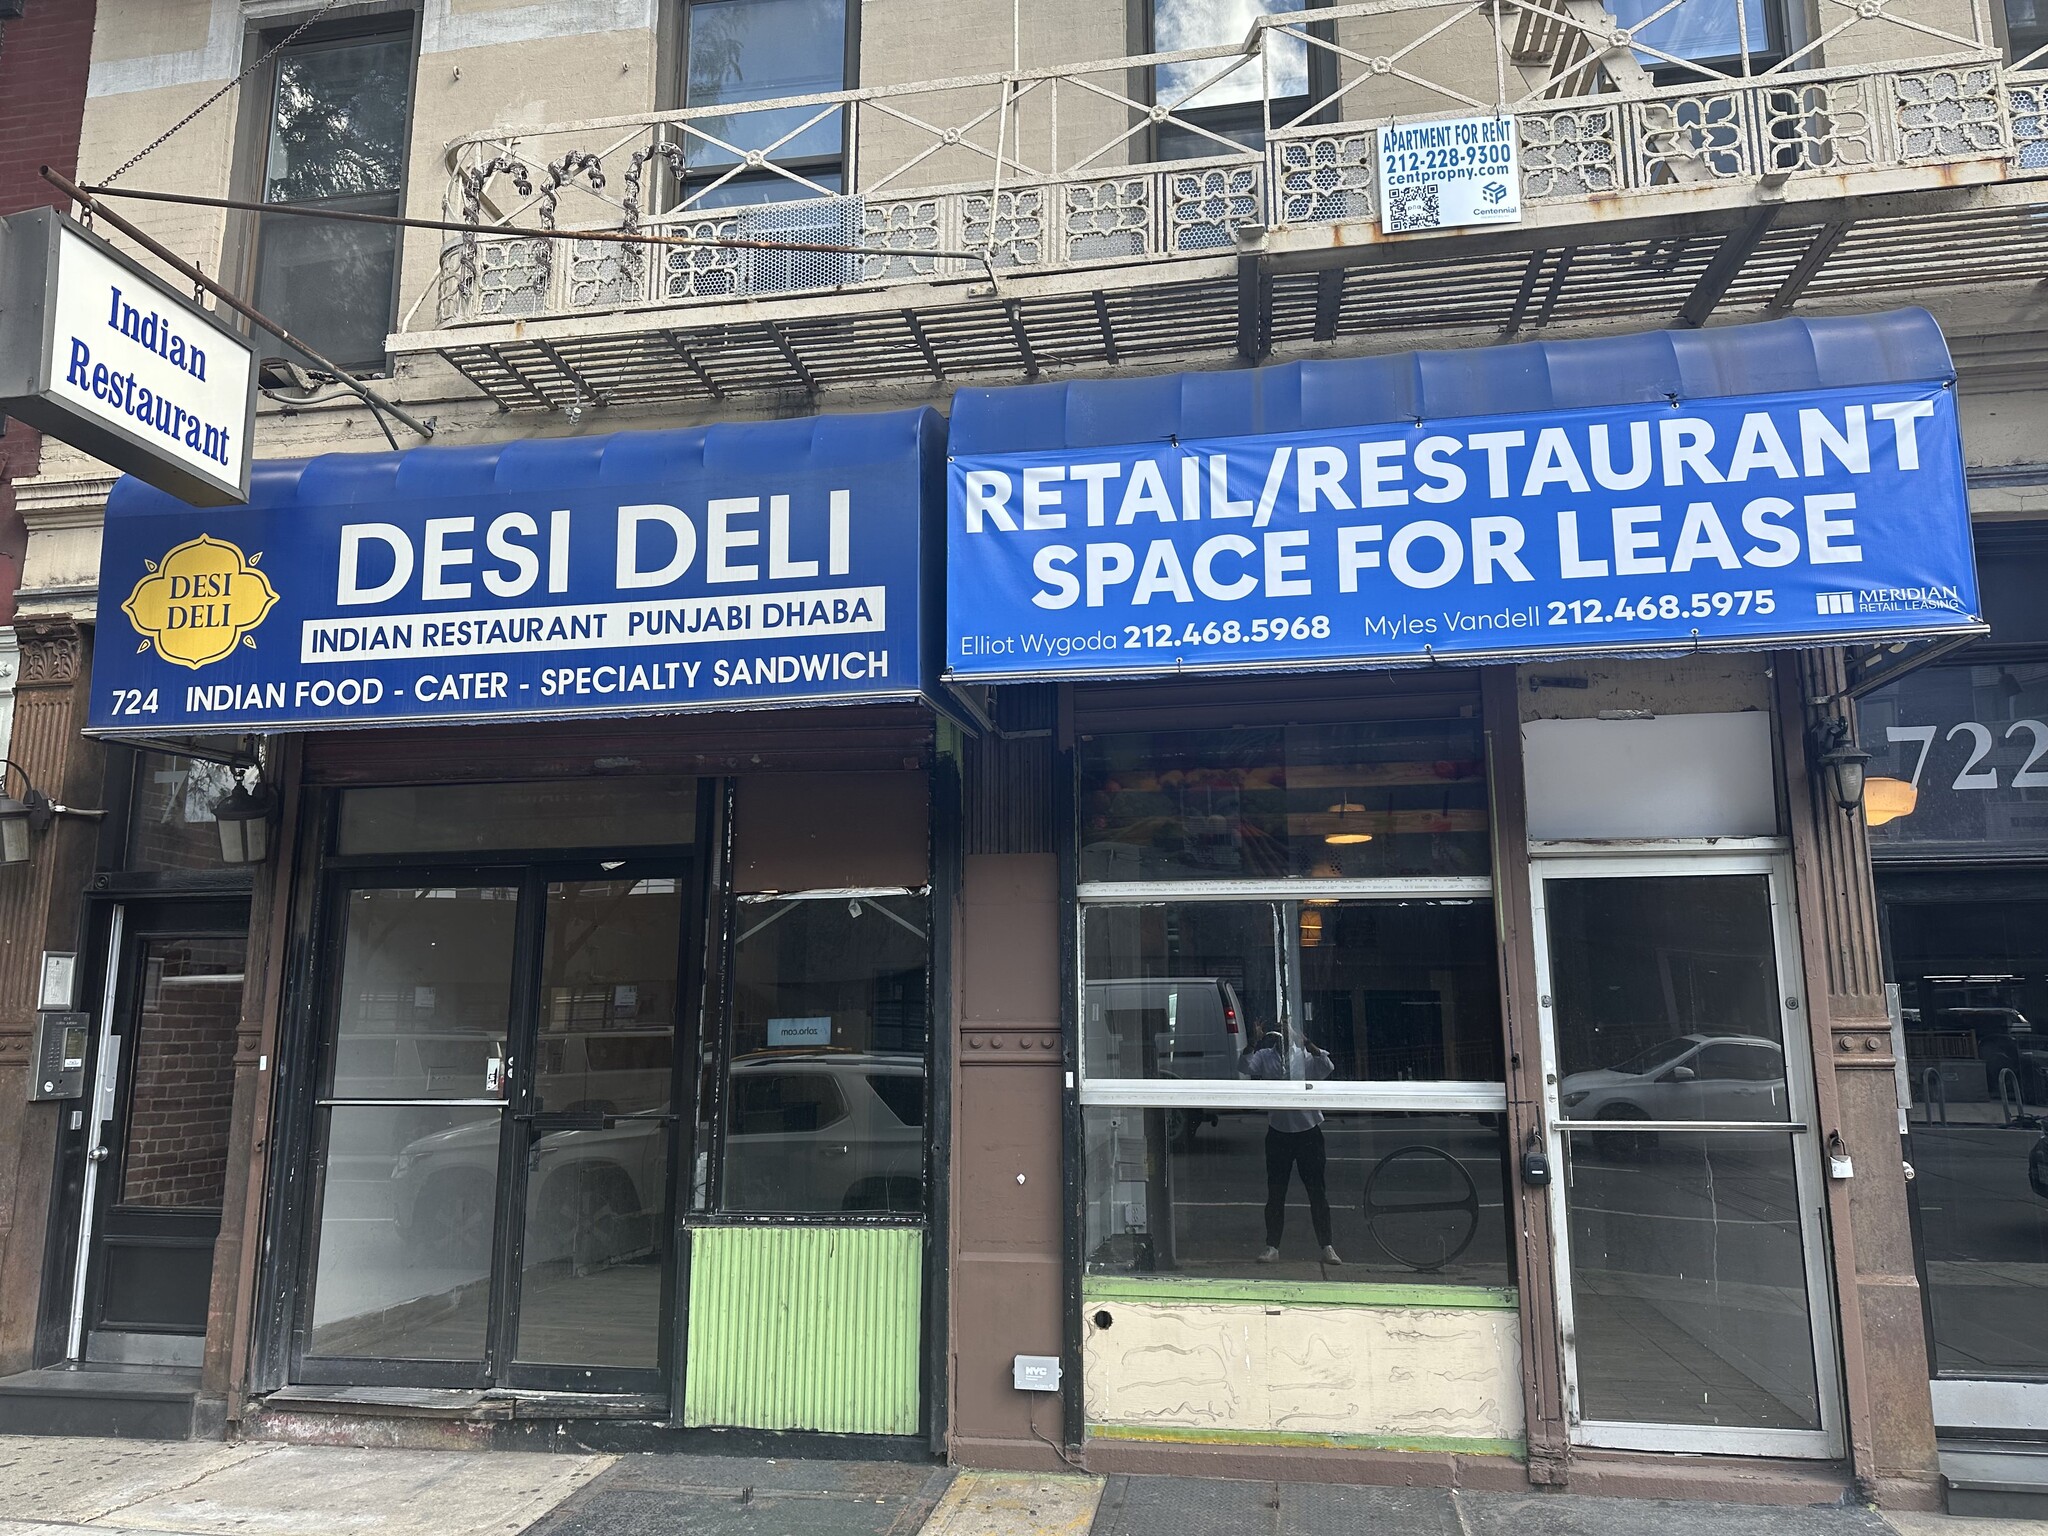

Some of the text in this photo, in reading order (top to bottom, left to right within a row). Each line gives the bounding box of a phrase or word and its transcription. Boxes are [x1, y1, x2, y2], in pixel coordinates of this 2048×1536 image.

[1383, 121, 1510, 153] APARTMENT FOR RENT
[1386, 144, 1510, 174] 212-228-9300
[1388, 164, 1508, 186] centpropny.com
[1473, 207, 1516, 215] Centennial
[108, 285, 206, 382] Indian
[66, 336, 230, 466] Restaurant
[966, 400, 1934, 533] RETAIL/RESTAURANT
[337, 490, 850, 606] DESI DELI
[1031, 492, 1863, 610] SPACE FOR LEASE
[169, 573, 231, 599] DESI
[1859, 586, 1957, 603] MERIDIAN
[167, 603, 230, 630] DELI
[1364, 590, 1775, 640] Myles Vandell 212.468.5975
[1860, 599, 1959, 612] RETAIL LEASING
[312, 598, 872, 653] INDIAN RESTAURANT PUNJABI DHABA
[961, 615, 1330, 657] Elliot Wygoda 212.468.5968
[186, 682, 286, 712] INDIAN
[295, 678, 383, 708] FOOD
[414, 672, 508, 702] CATER
[541, 661, 701, 696] SPECIALTY
[713, 650, 888, 687] SANDWICH
[111, 689, 159, 716] 724
[1886, 720, 2048, 791] 722
[1025, 1366, 1047, 1375] NYC
